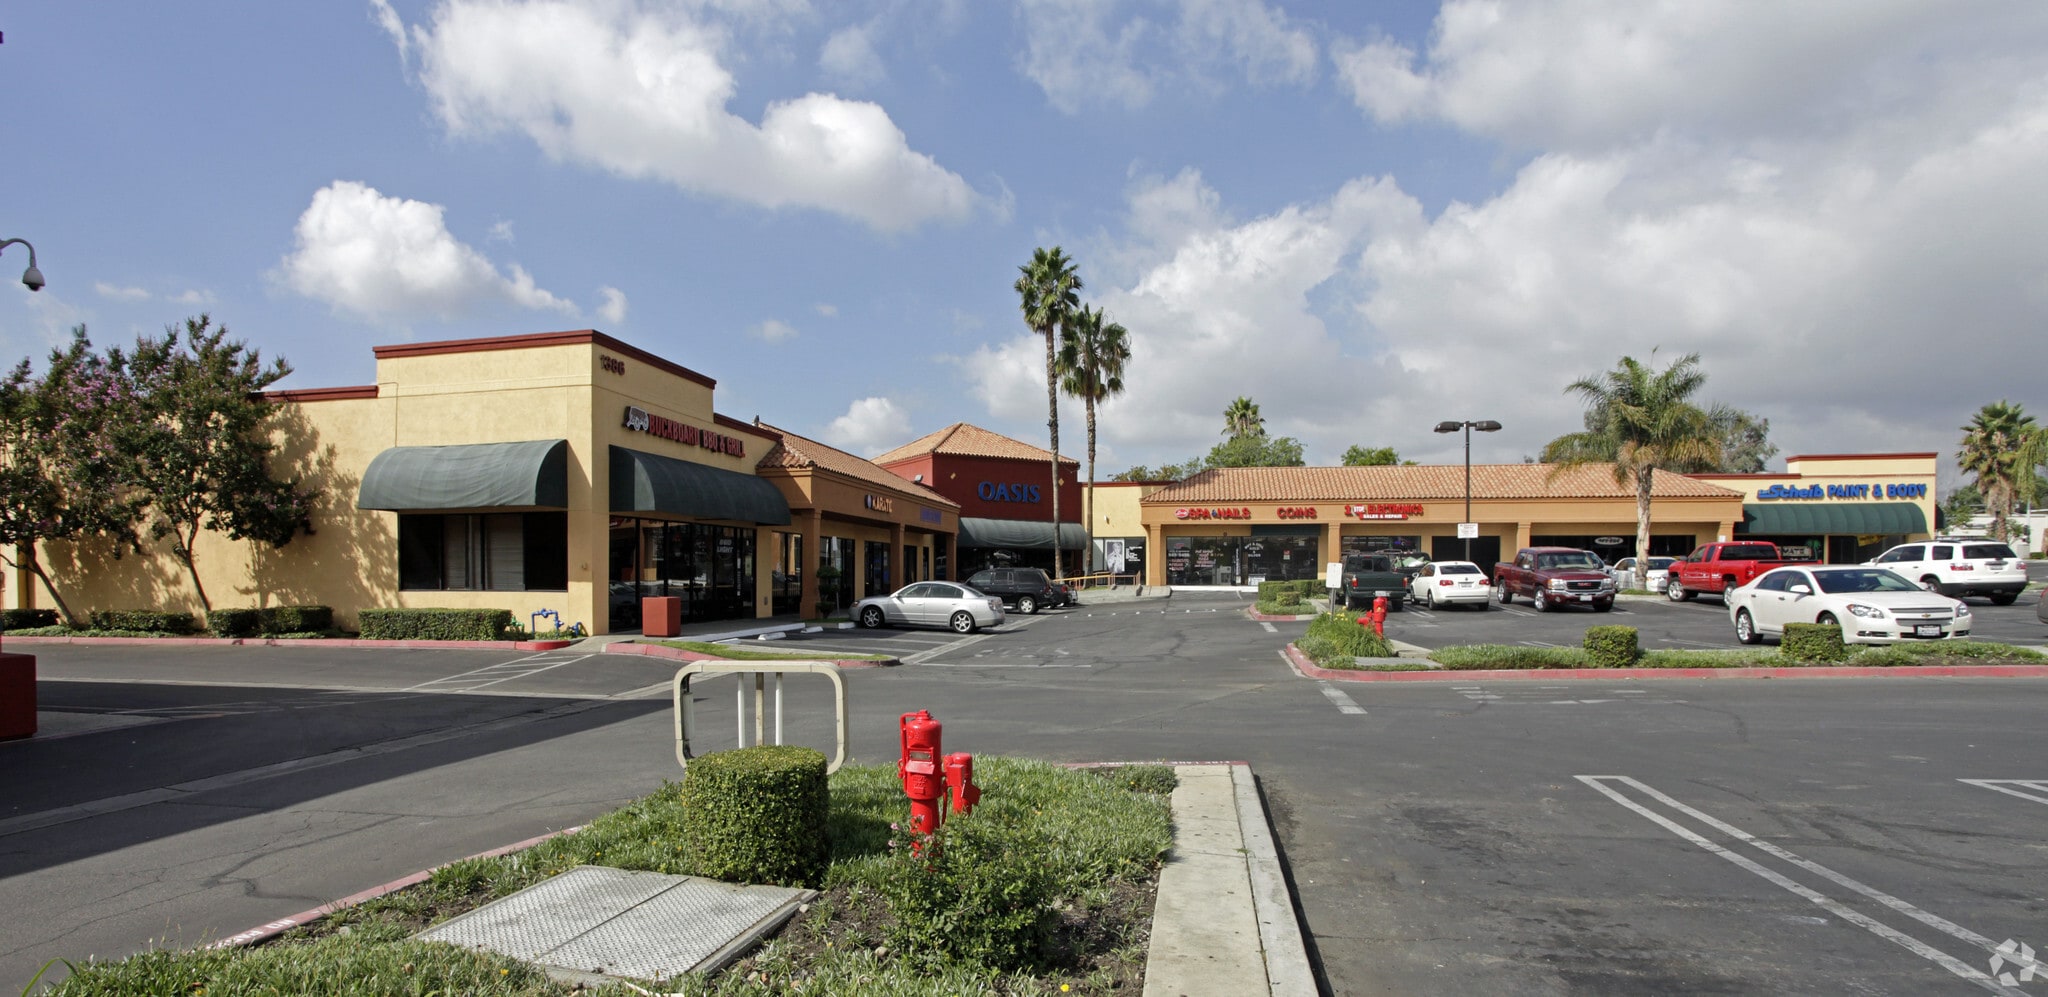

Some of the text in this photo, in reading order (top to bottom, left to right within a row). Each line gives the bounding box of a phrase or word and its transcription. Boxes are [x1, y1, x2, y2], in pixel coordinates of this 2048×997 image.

[649, 413, 746, 458] BUCKBOARD BBQ & GRILL
[977, 480, 1040, 504] OASIS
[1767, 483, 1928, 499] Scheib PAINT & BODY
[1188, 507, 1211, 520] SPA
[1217, 507, 1252, 520] NAILS
[1276, 506, 1317, 519] COINS
[1368, 503, 1424, 515] ELECTRONICS
